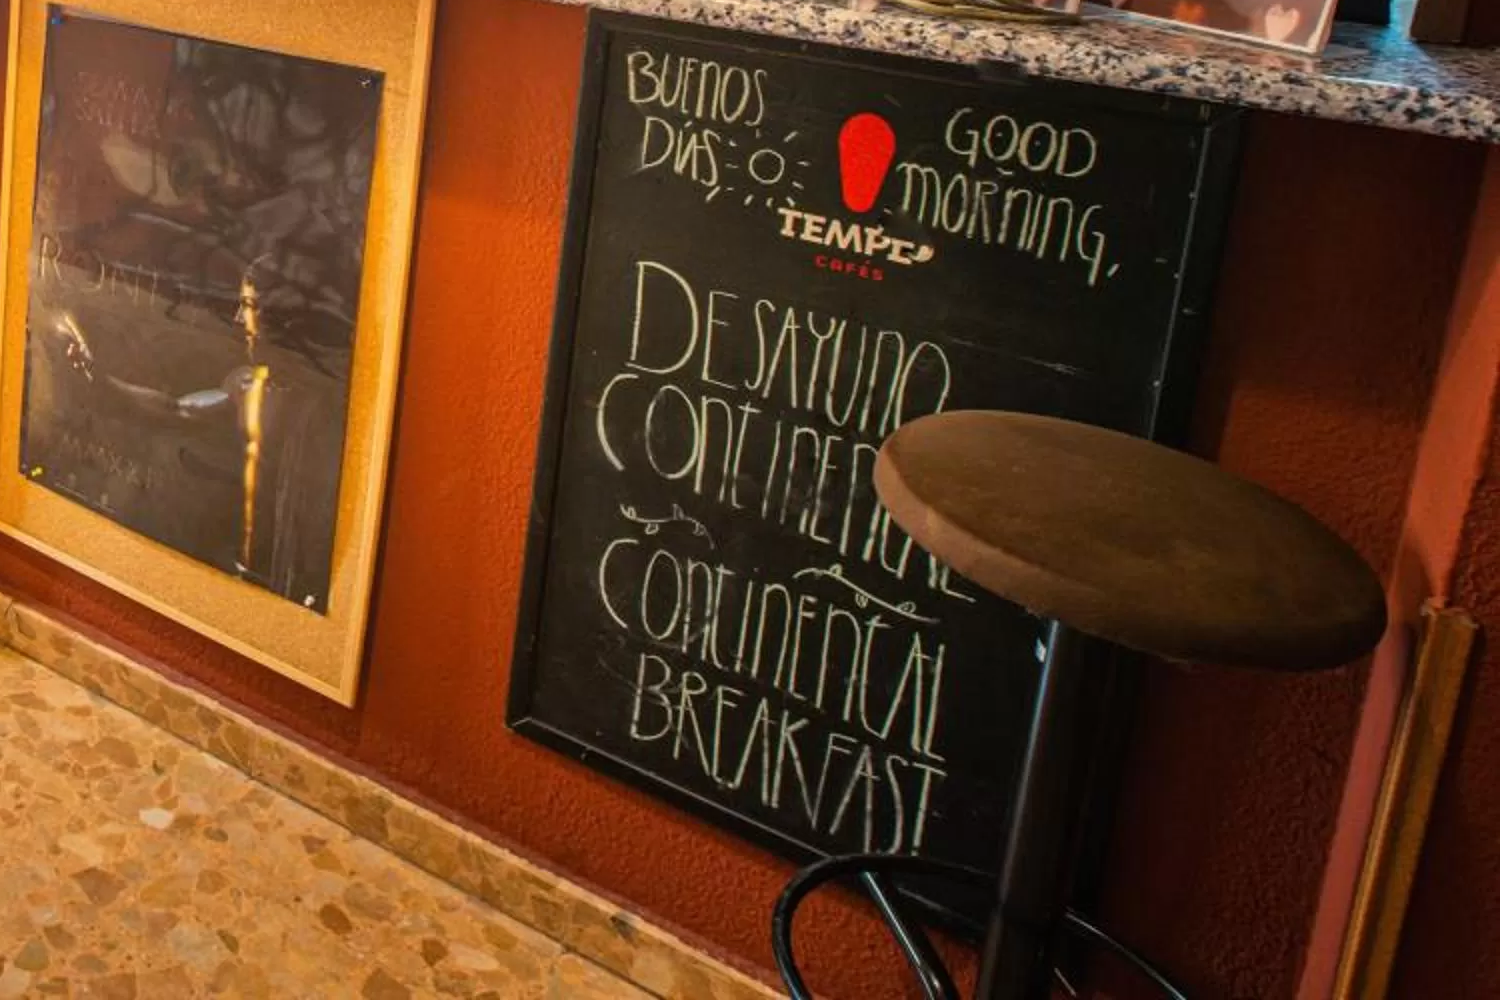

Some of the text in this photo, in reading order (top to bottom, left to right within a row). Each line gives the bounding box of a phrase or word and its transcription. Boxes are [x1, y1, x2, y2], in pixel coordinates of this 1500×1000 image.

[627, 50, 768, 127] BUENOS
[945, 106, 1097, 178] GOOD
[624, 260, 952, 440] DESAYUNO
[599, 538, 947, 764] CONTINENTAL
[630, 652, 948, 858] BREAKFAST
